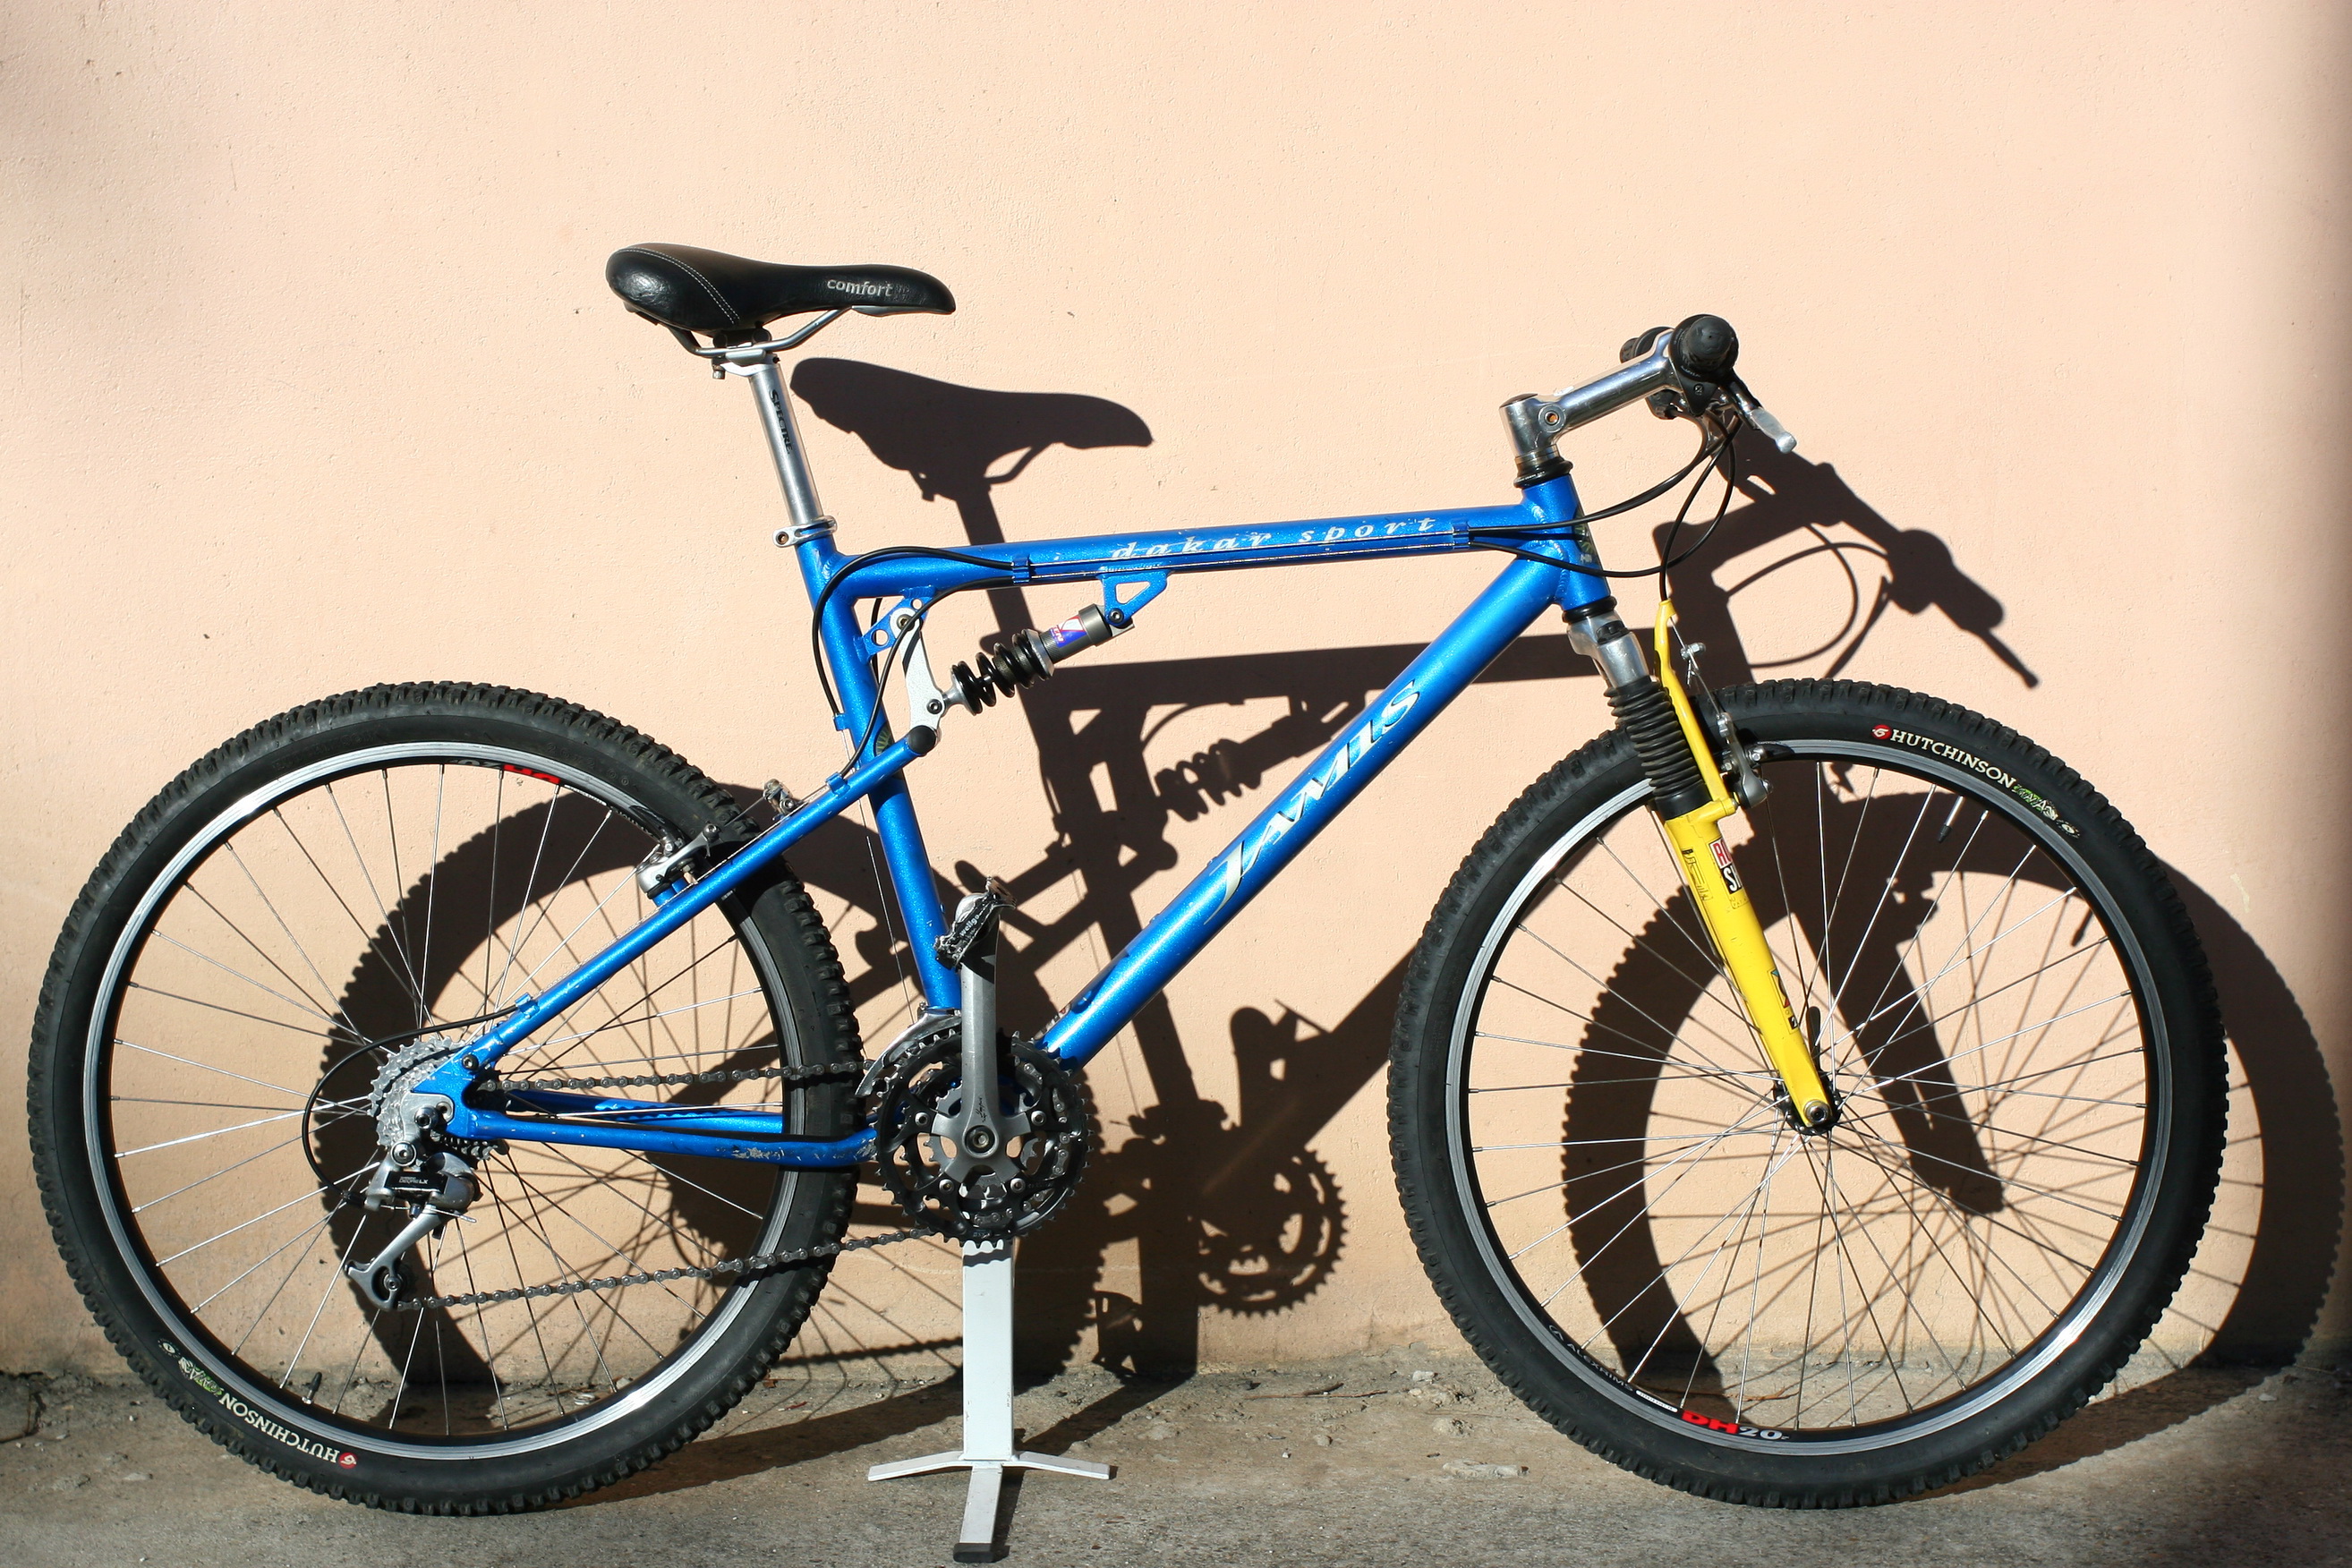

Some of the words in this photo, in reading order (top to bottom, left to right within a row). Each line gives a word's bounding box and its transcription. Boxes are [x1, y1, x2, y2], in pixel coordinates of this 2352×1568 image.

[827, 278, 893, 297] comfort
[1111, 528, 1273, 559] dakar
[1298, 516, 1437, 544] sport
[1889, 729, 2016, 789] HUTCHINSON
[959, 914, 980, 937] wellgo
[218, 1393, 341, 1463] HUTCHINSON
